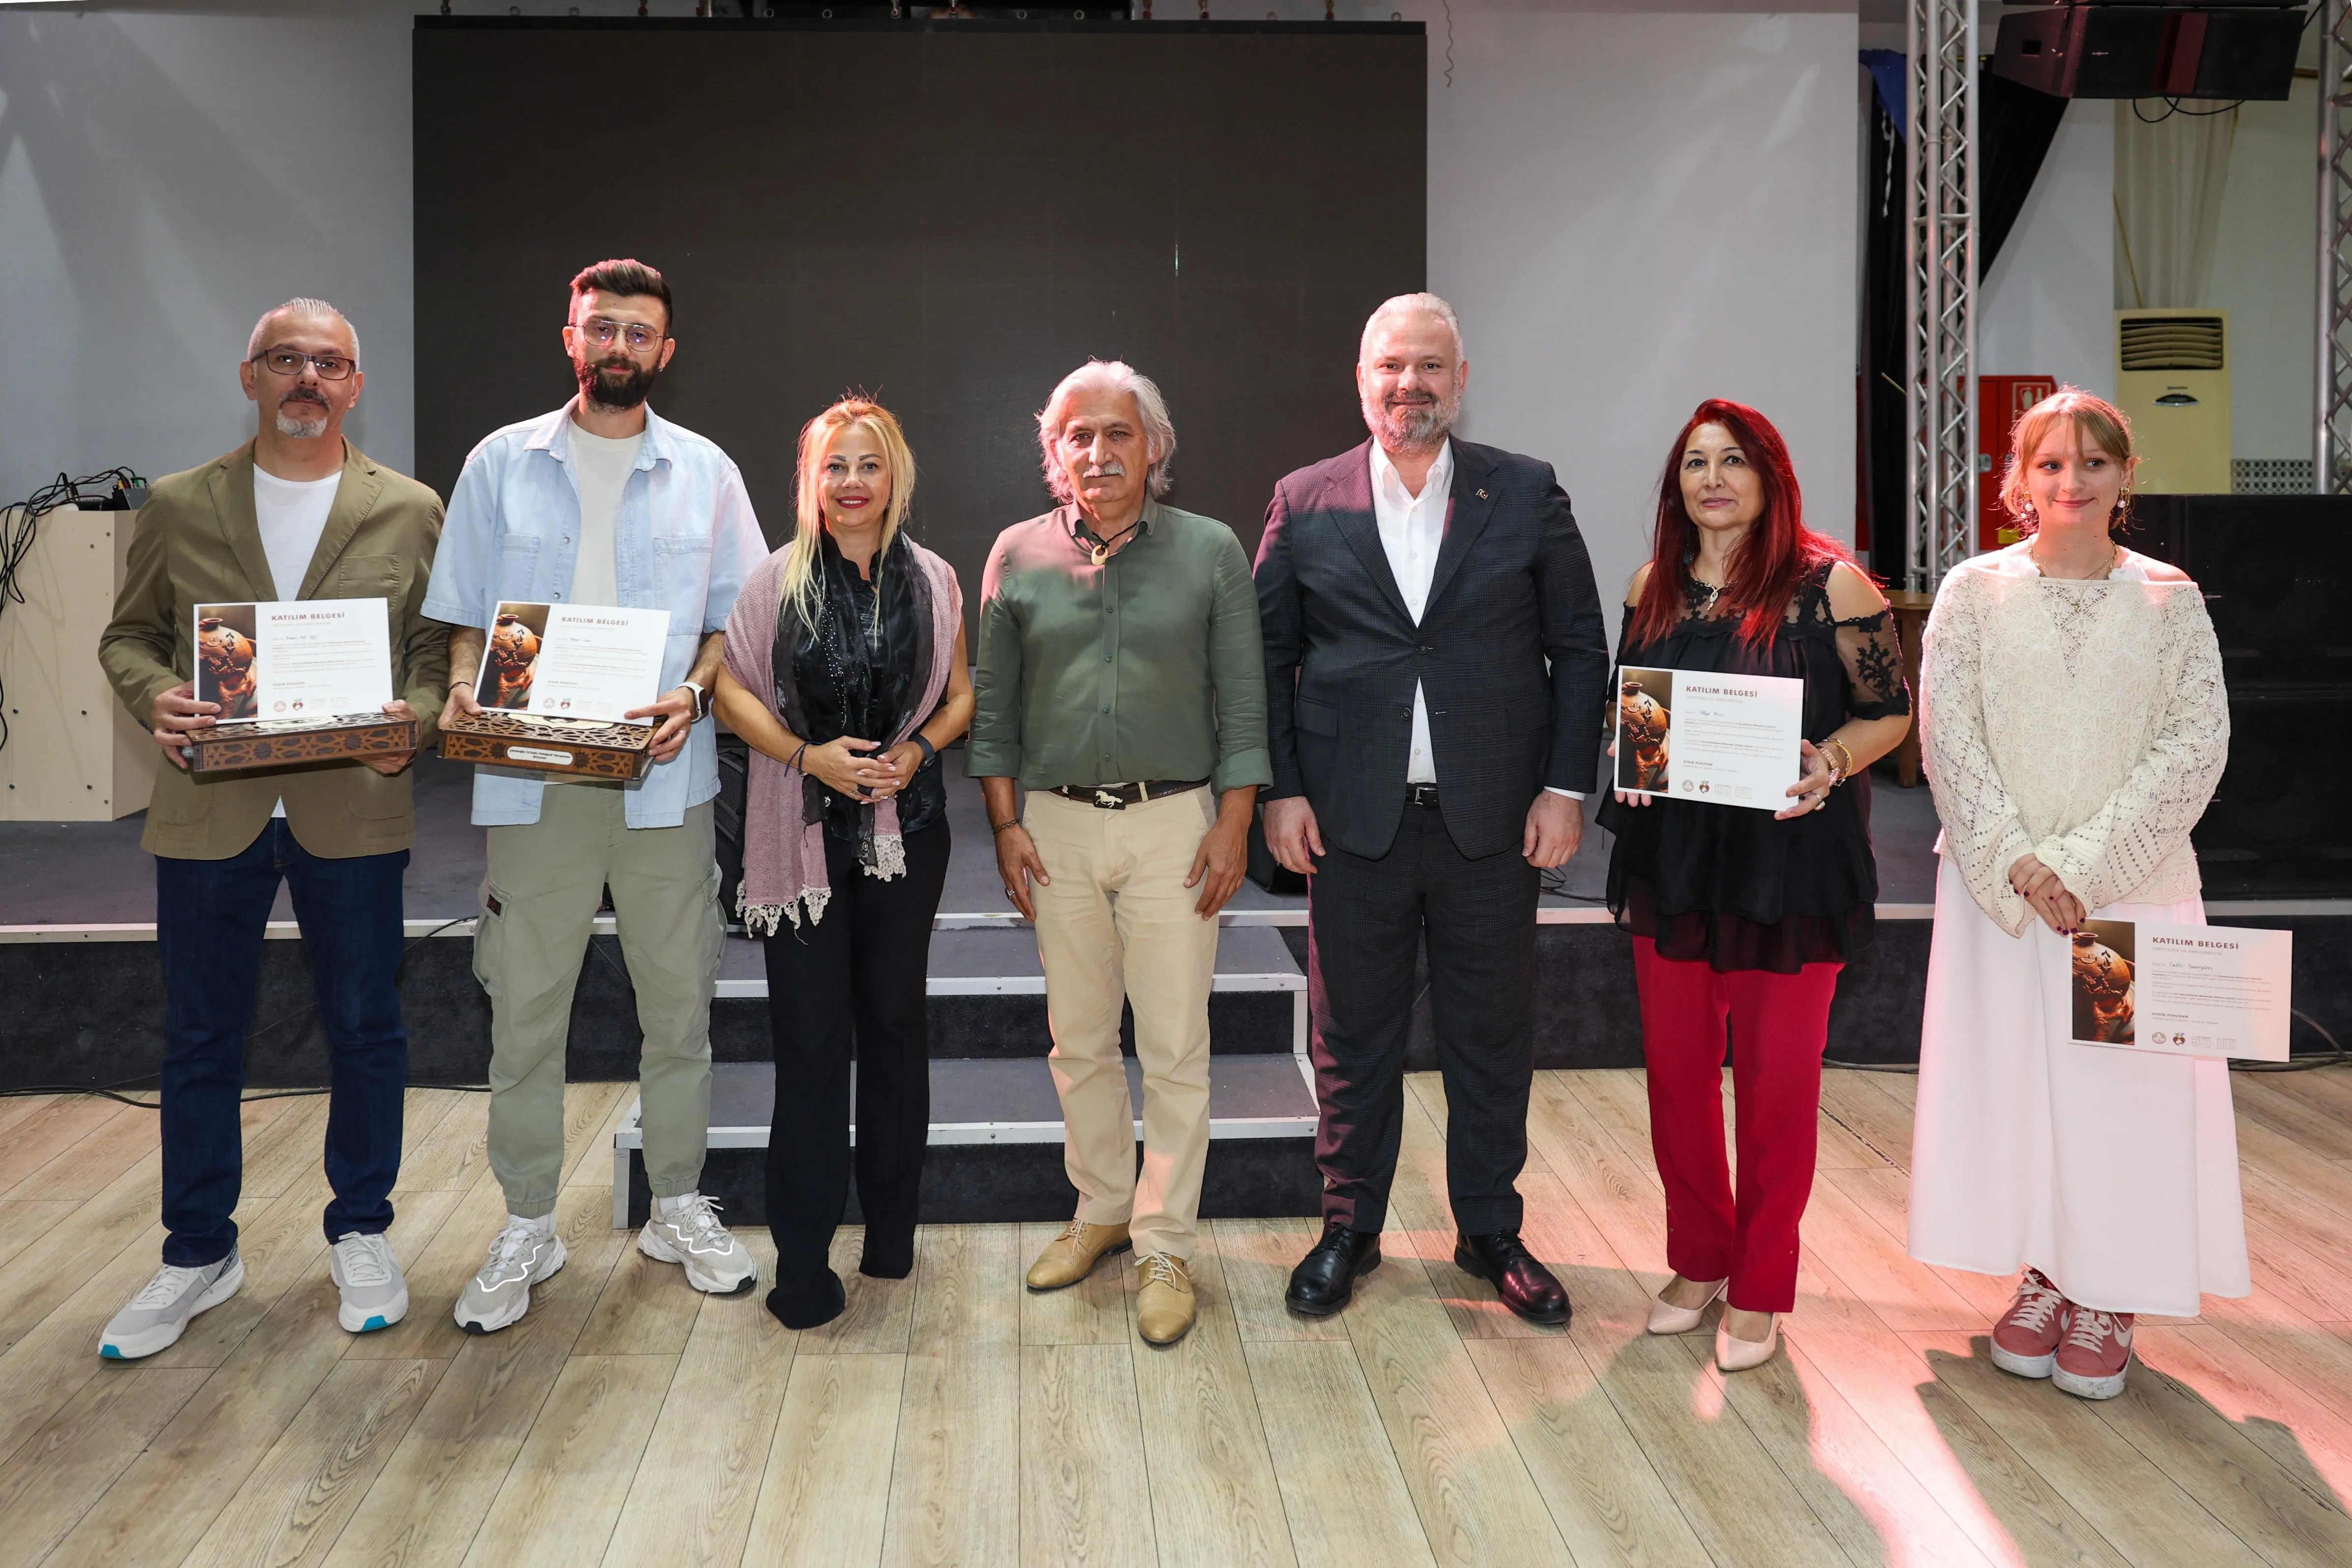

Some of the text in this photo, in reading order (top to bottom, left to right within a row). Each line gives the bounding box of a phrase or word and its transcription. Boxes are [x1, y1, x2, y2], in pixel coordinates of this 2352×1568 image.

[1686, 686, 1757, 697] KATILIM BELGESİ
[2152, 937, 2239, 950] KATILIM BELGESİ
